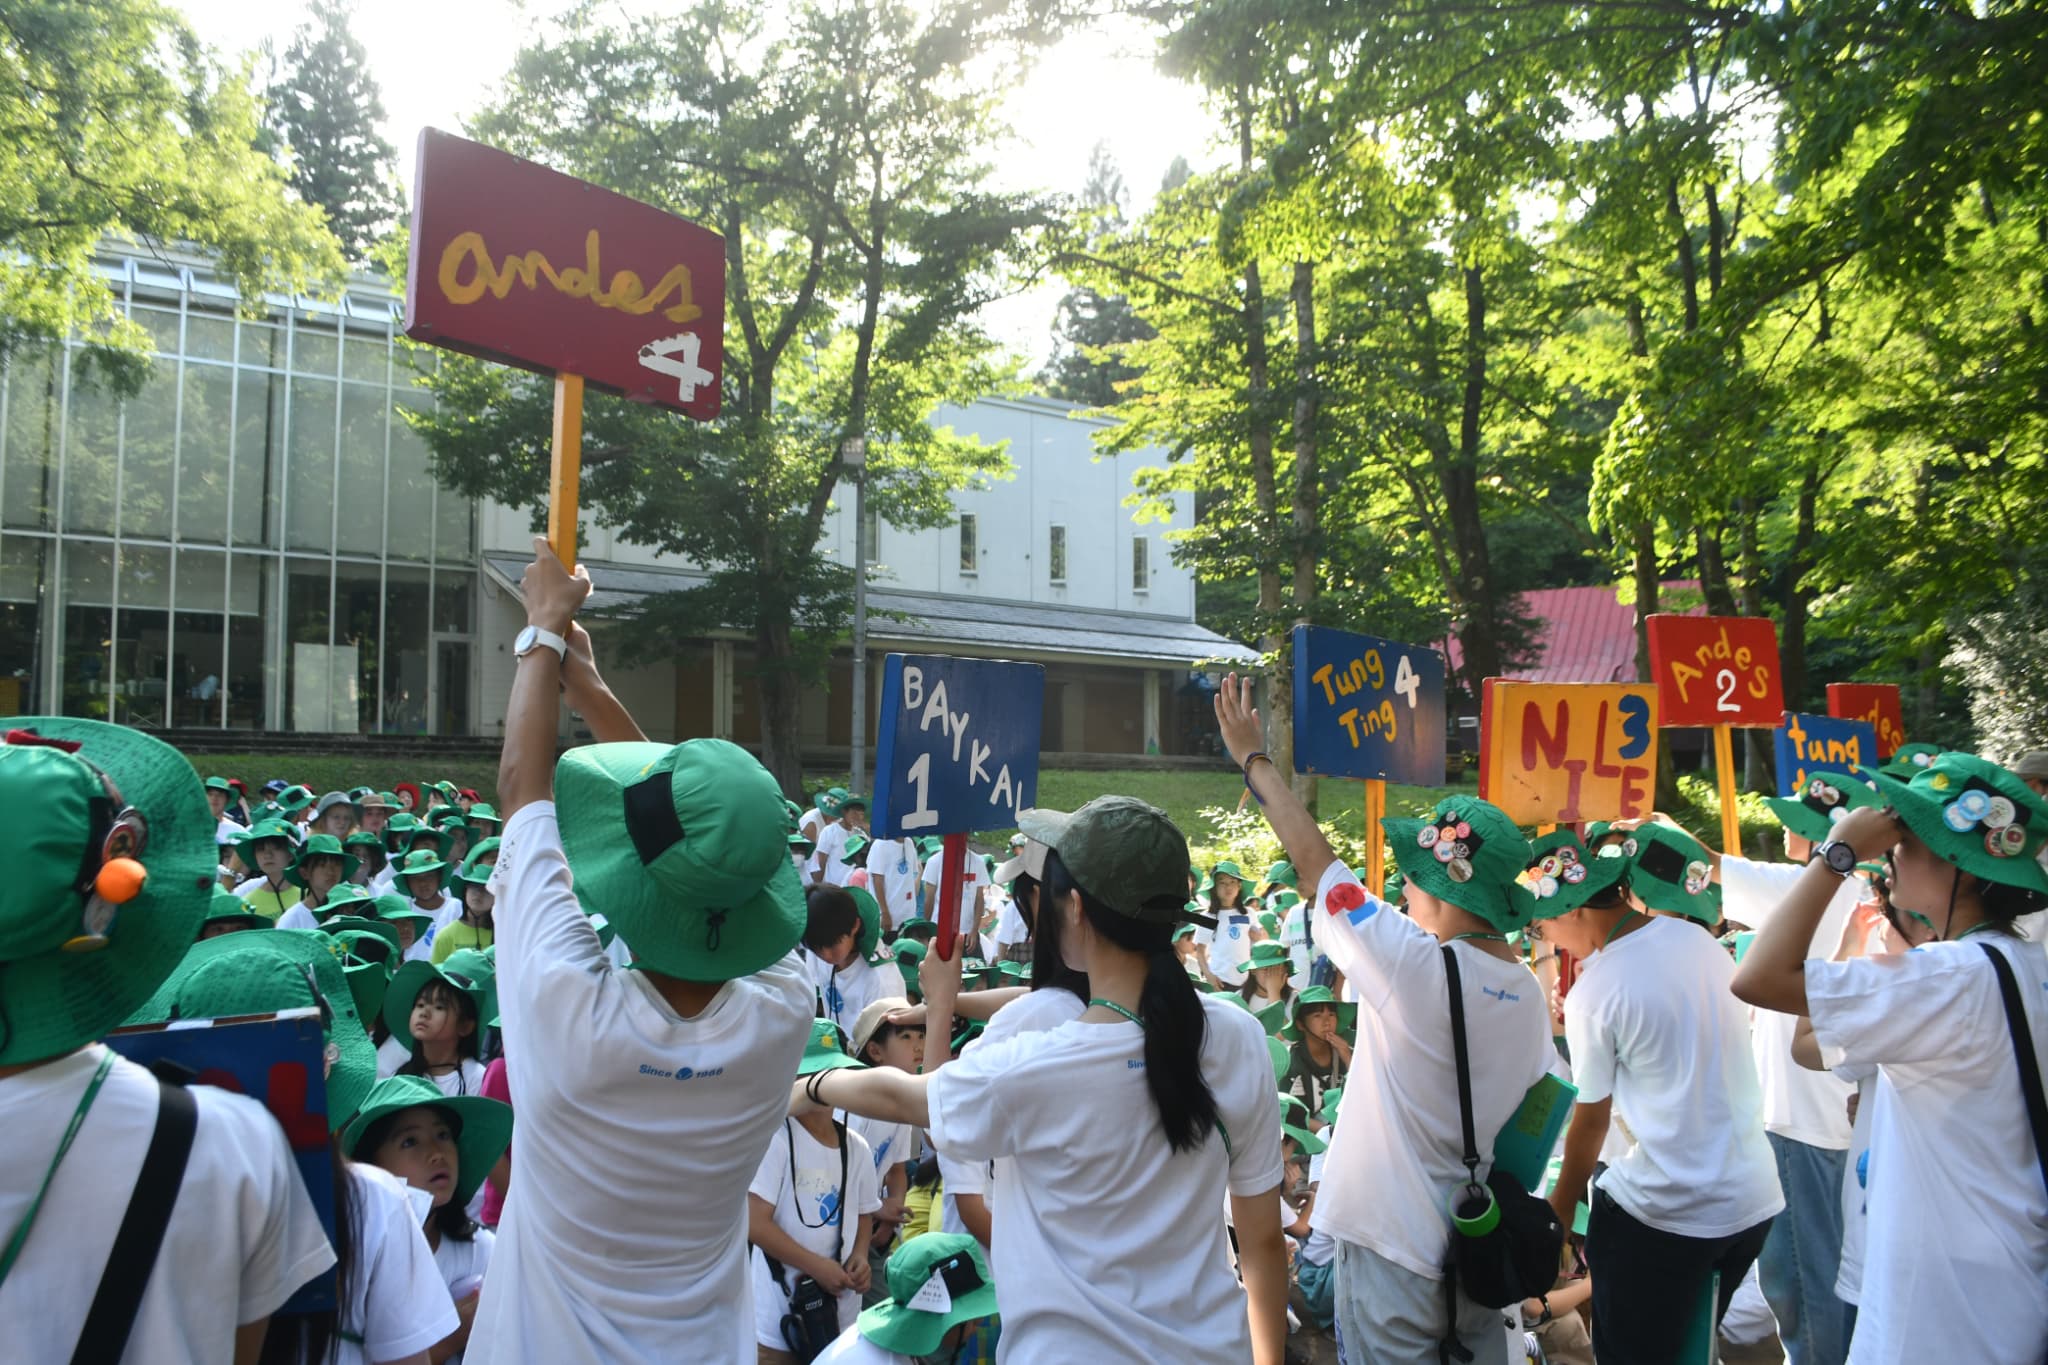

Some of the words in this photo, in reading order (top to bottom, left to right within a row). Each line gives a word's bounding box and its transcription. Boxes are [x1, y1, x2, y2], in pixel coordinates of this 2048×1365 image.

[638, 332, 714, 402] 4
[1312, 648, 1385, 705] Tung
[1394, 655, 1420, 708] 4
[1671, 626, 1769, 703] Andes
[1716, 669, 1741, 711] 2
[903, 666, 1034, 822] BAYKAL
[1339, 699, 1397, 749] Ting
[1618, 694, 1650, 759] 3
[1787, 714, 1860, 774] tung
[901, 753, 939, 829] 1
[1521, 699, 1649, 823] NILE
[639, 1064, 672, 1078] Since
